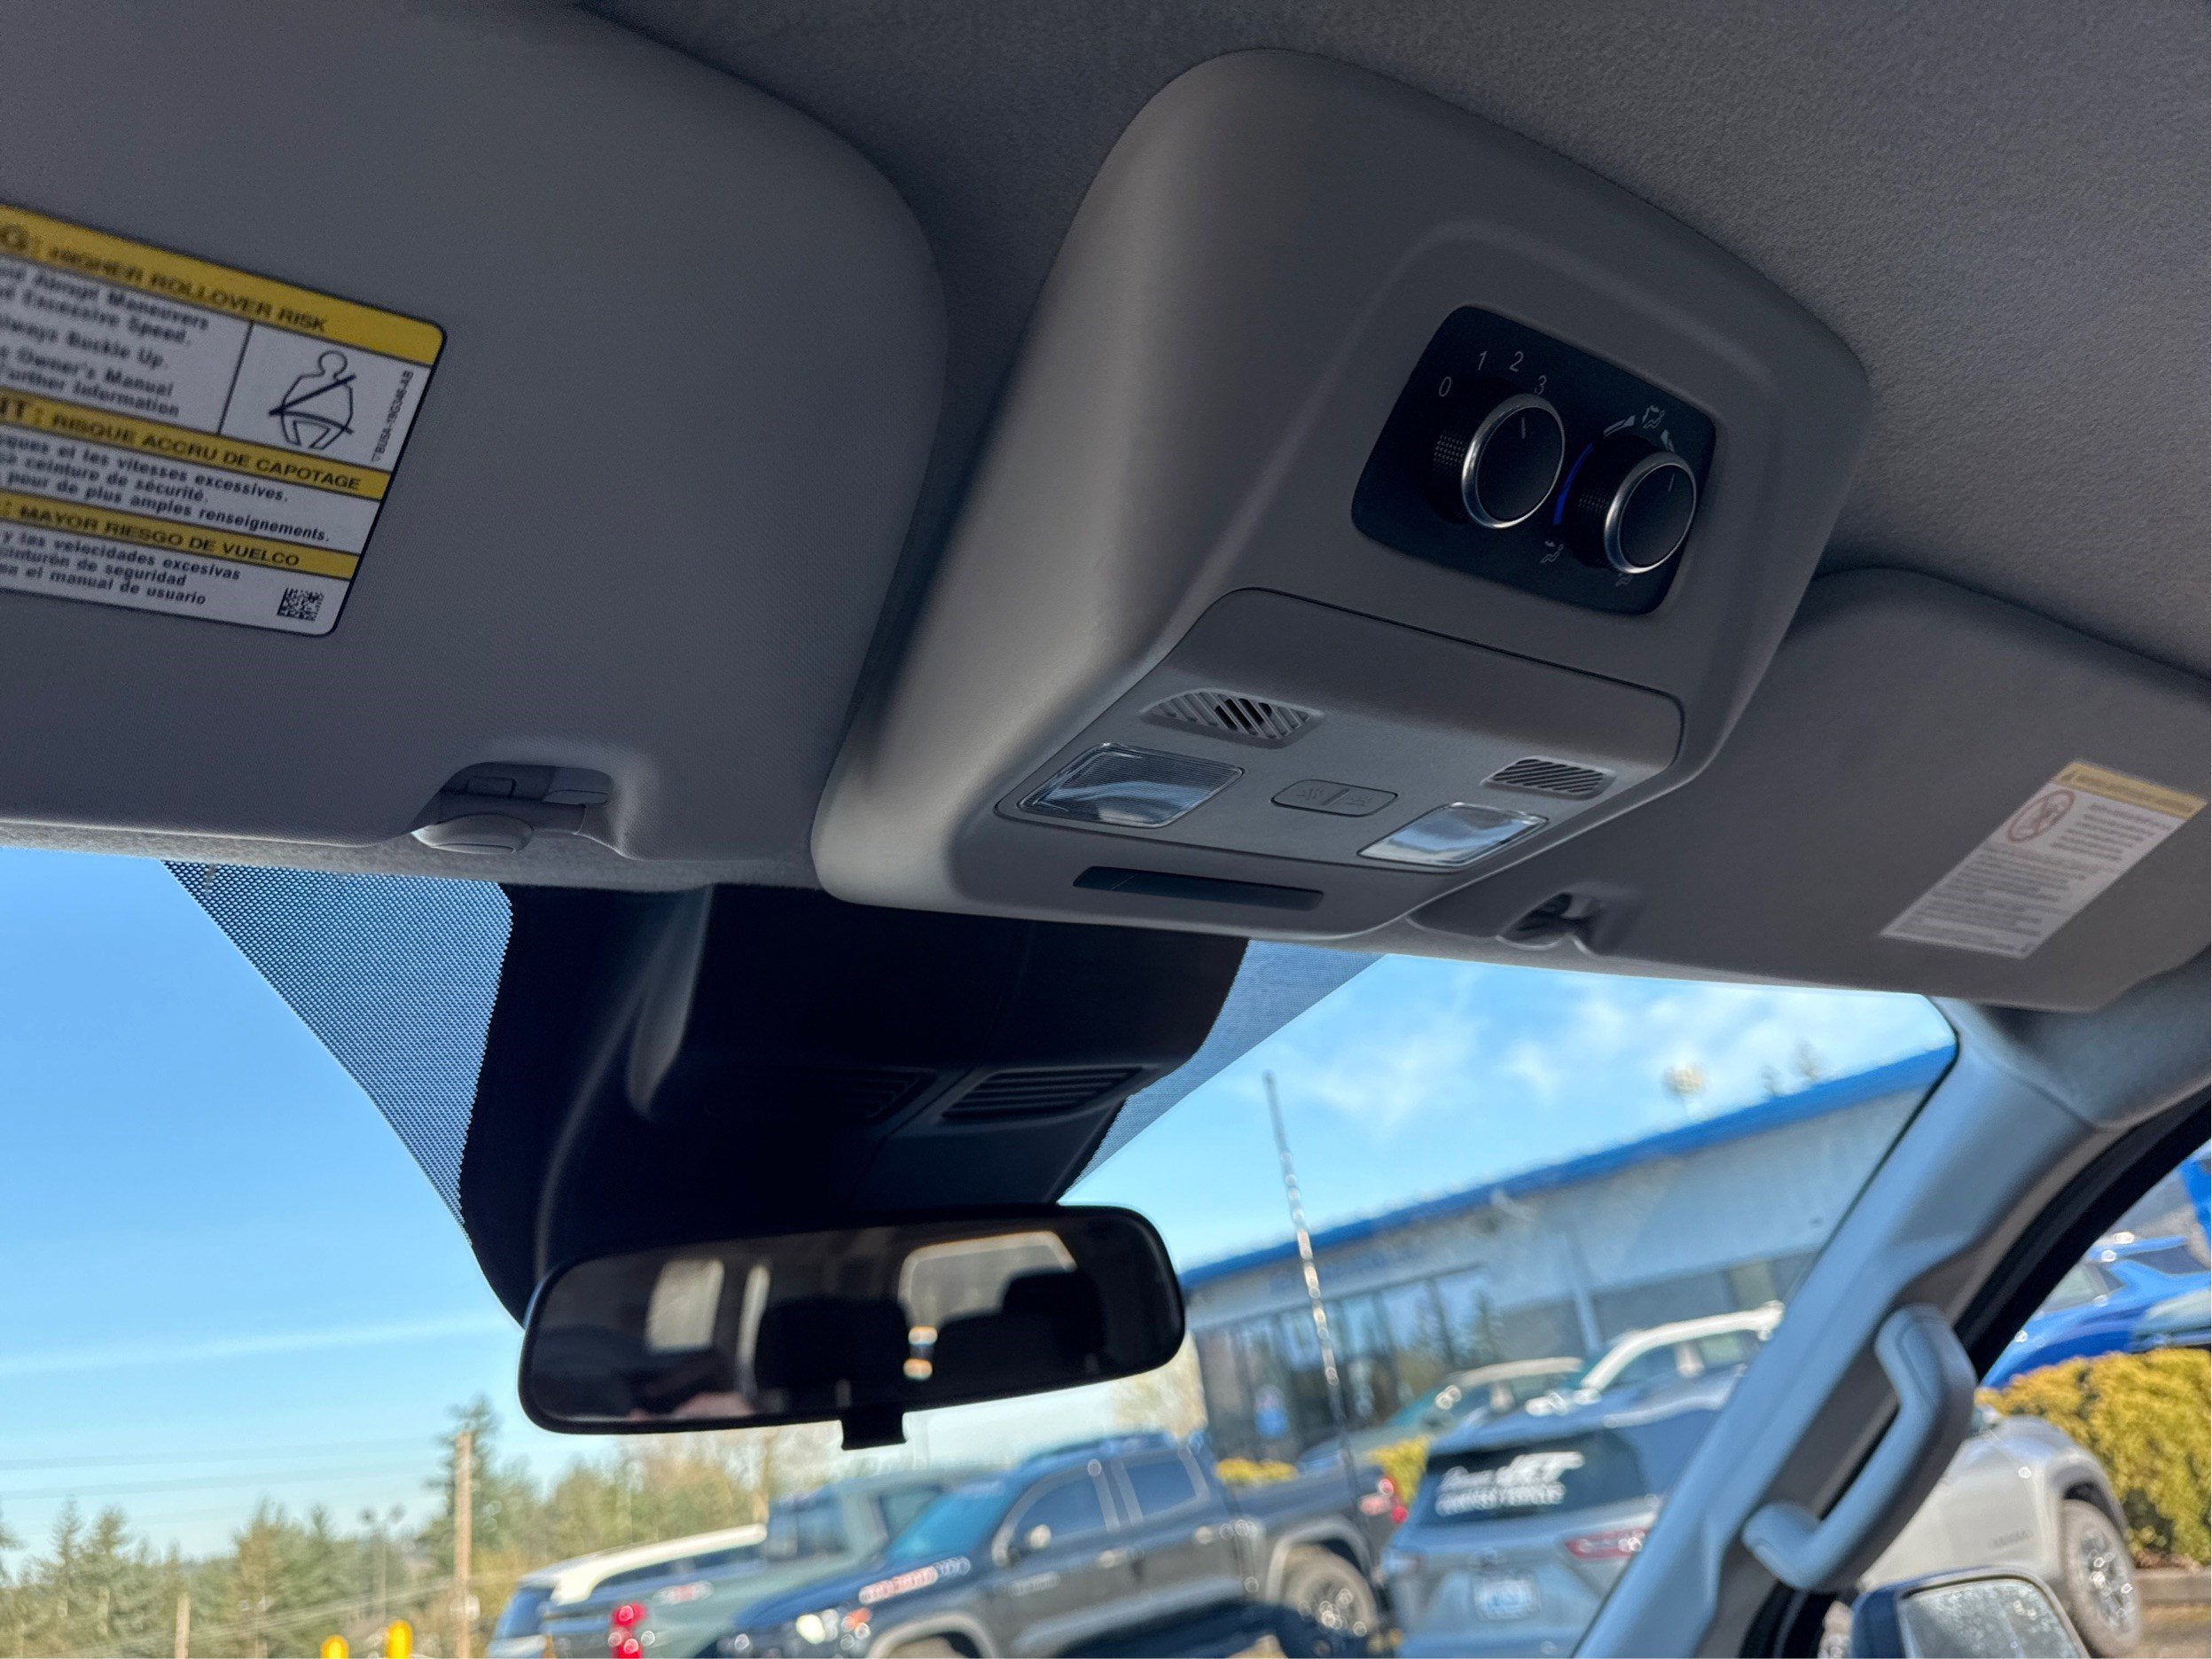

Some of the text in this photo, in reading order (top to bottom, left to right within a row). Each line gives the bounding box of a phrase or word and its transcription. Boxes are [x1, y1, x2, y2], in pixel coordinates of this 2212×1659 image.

[22, 288, 120, 327] Excessive
[127, 316, 191, 346] Speed.
[106, 290, 209, 331] Maneuvers
[150, 271, 272, 317] ROLLOVER
[277, 308, 327, 333] RISK
[66, 329, 130, 359] Buckle
[16, 346, 97, 380] Owner's
[105, 367, 175, 397] Manual
[1438, 350, 1547, 397] 0 1 2 3
[73, 380, 179, 417] Information
[53, 412, 135, 442] RISQUE
[142, 434, 218, 461] ACCRU
[223, 450, 250, 466] DE
[256, 457, 362, 490] CAPOTAGE
[58, 445, 76, 460] et
[83, 447, 110, 467] les
[118, 456, 188, 482] vitesses
[194, 473, 288, 503] excessives.
[25, 457, 101, 482] ceinture
[106, 470, 129, 488] de
[136, 478, 208, 504] sécurité.
[8, 471, 330, 542] pour de plus amples renseignements.
[20, 504, 98, 531] MAYOR
[105, 520, 185, 546] RIESGO
[189, 536, 215, 552] DE
[222, 540, 301, 567] VUELCO
[20, 531, 46, 548] las
[54, 539, 156, 567] velocidades
[162, 556, 241, 581] excesivas
[26, 566, 43, 580] el
[50, 570, 114, 590] manual
[120, 580, 141, 596] de
[146, 586, 207, 606] usuario
[77, 559, 98, 574] de
[106, 563, 188, 588] seguridad
